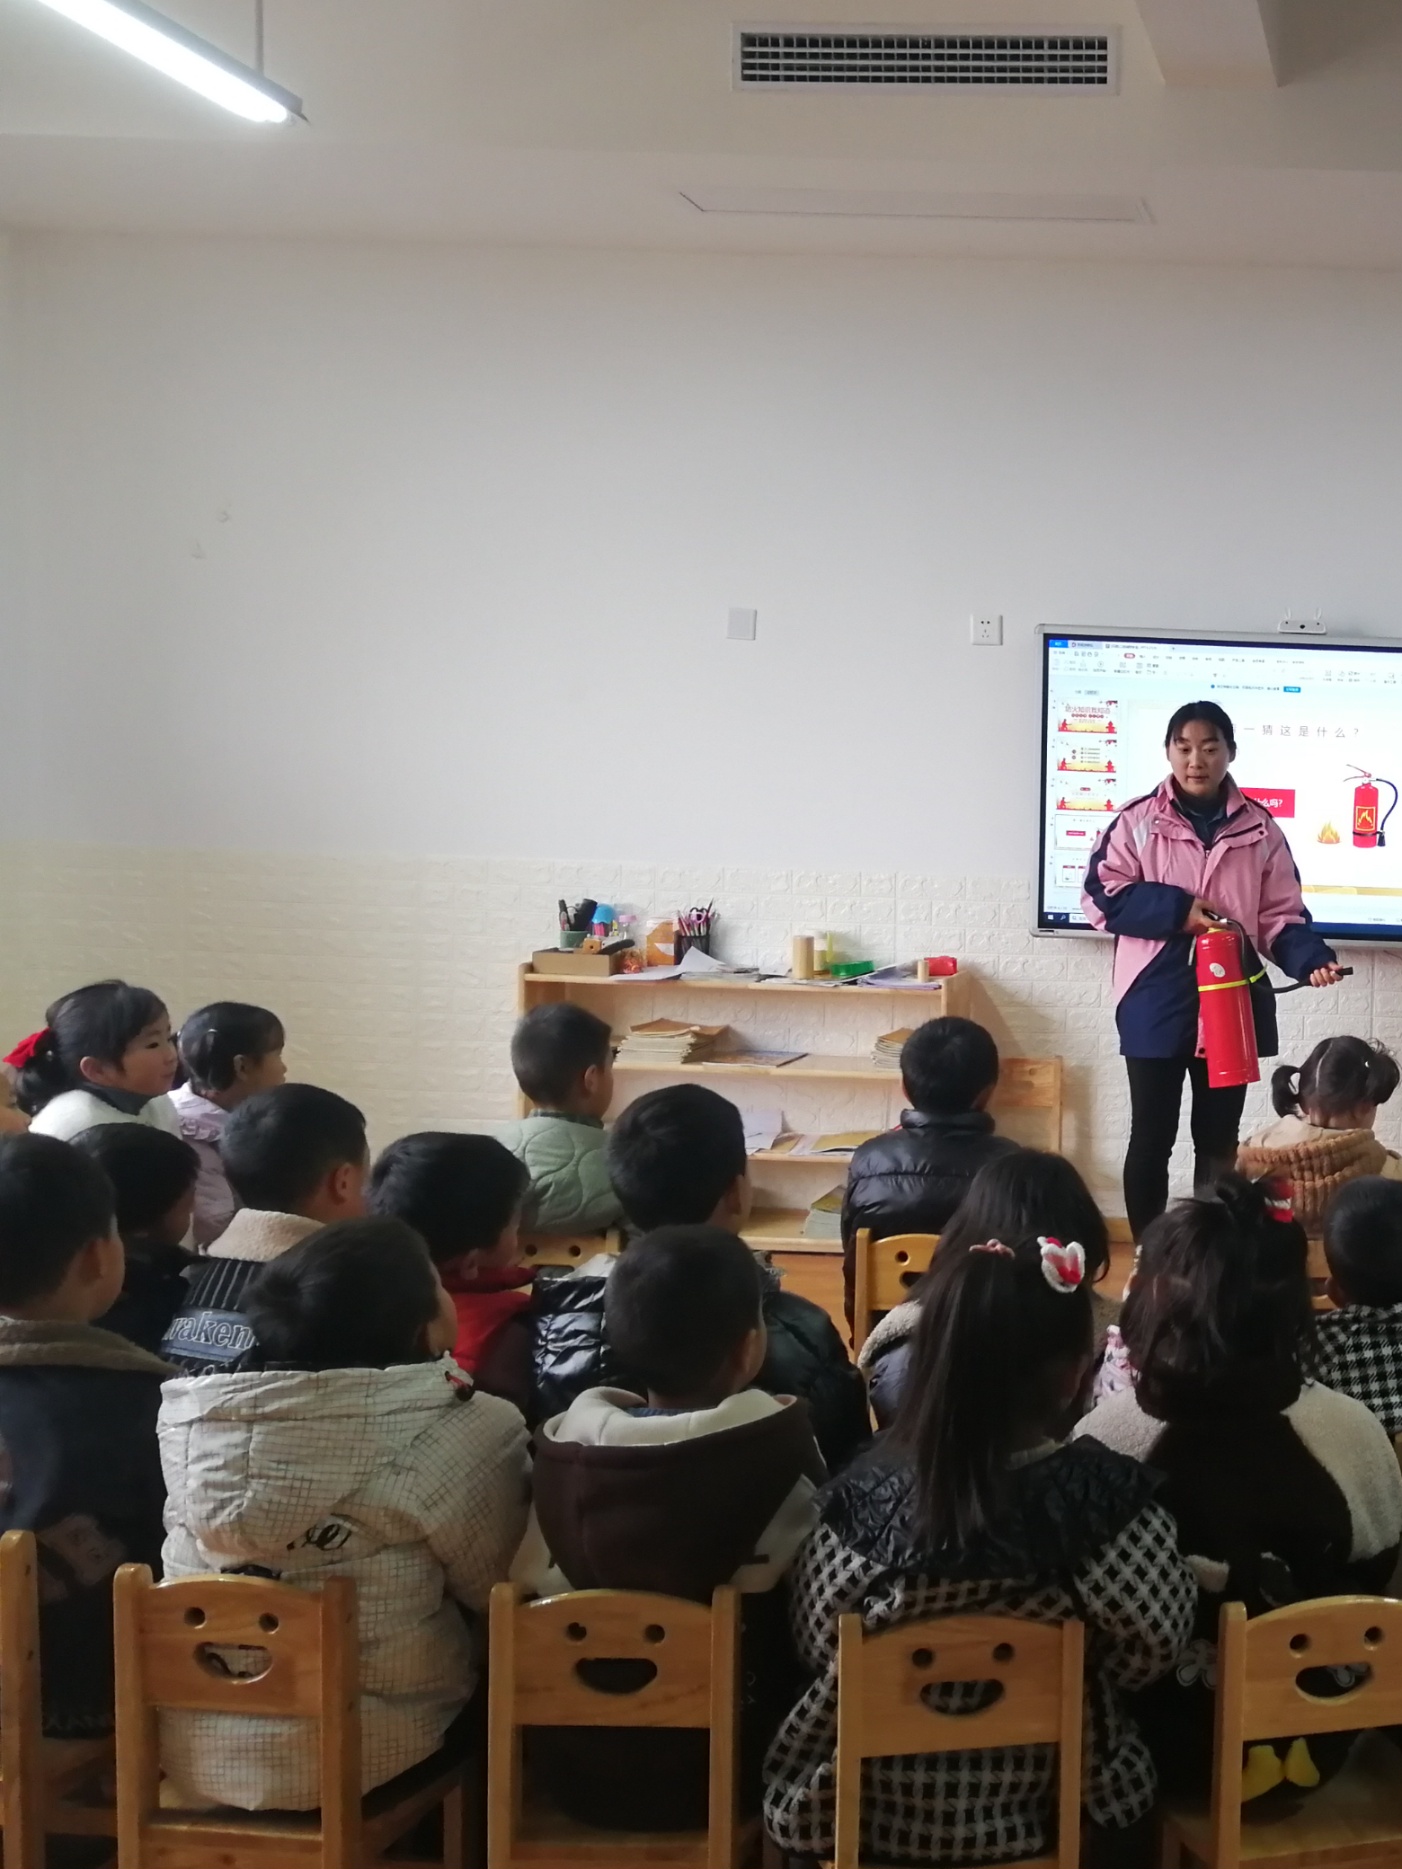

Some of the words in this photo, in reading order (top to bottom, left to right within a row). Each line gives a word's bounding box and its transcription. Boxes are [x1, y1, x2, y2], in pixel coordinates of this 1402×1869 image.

[1232, 724, 1359, 738] 一猜这是什么?
